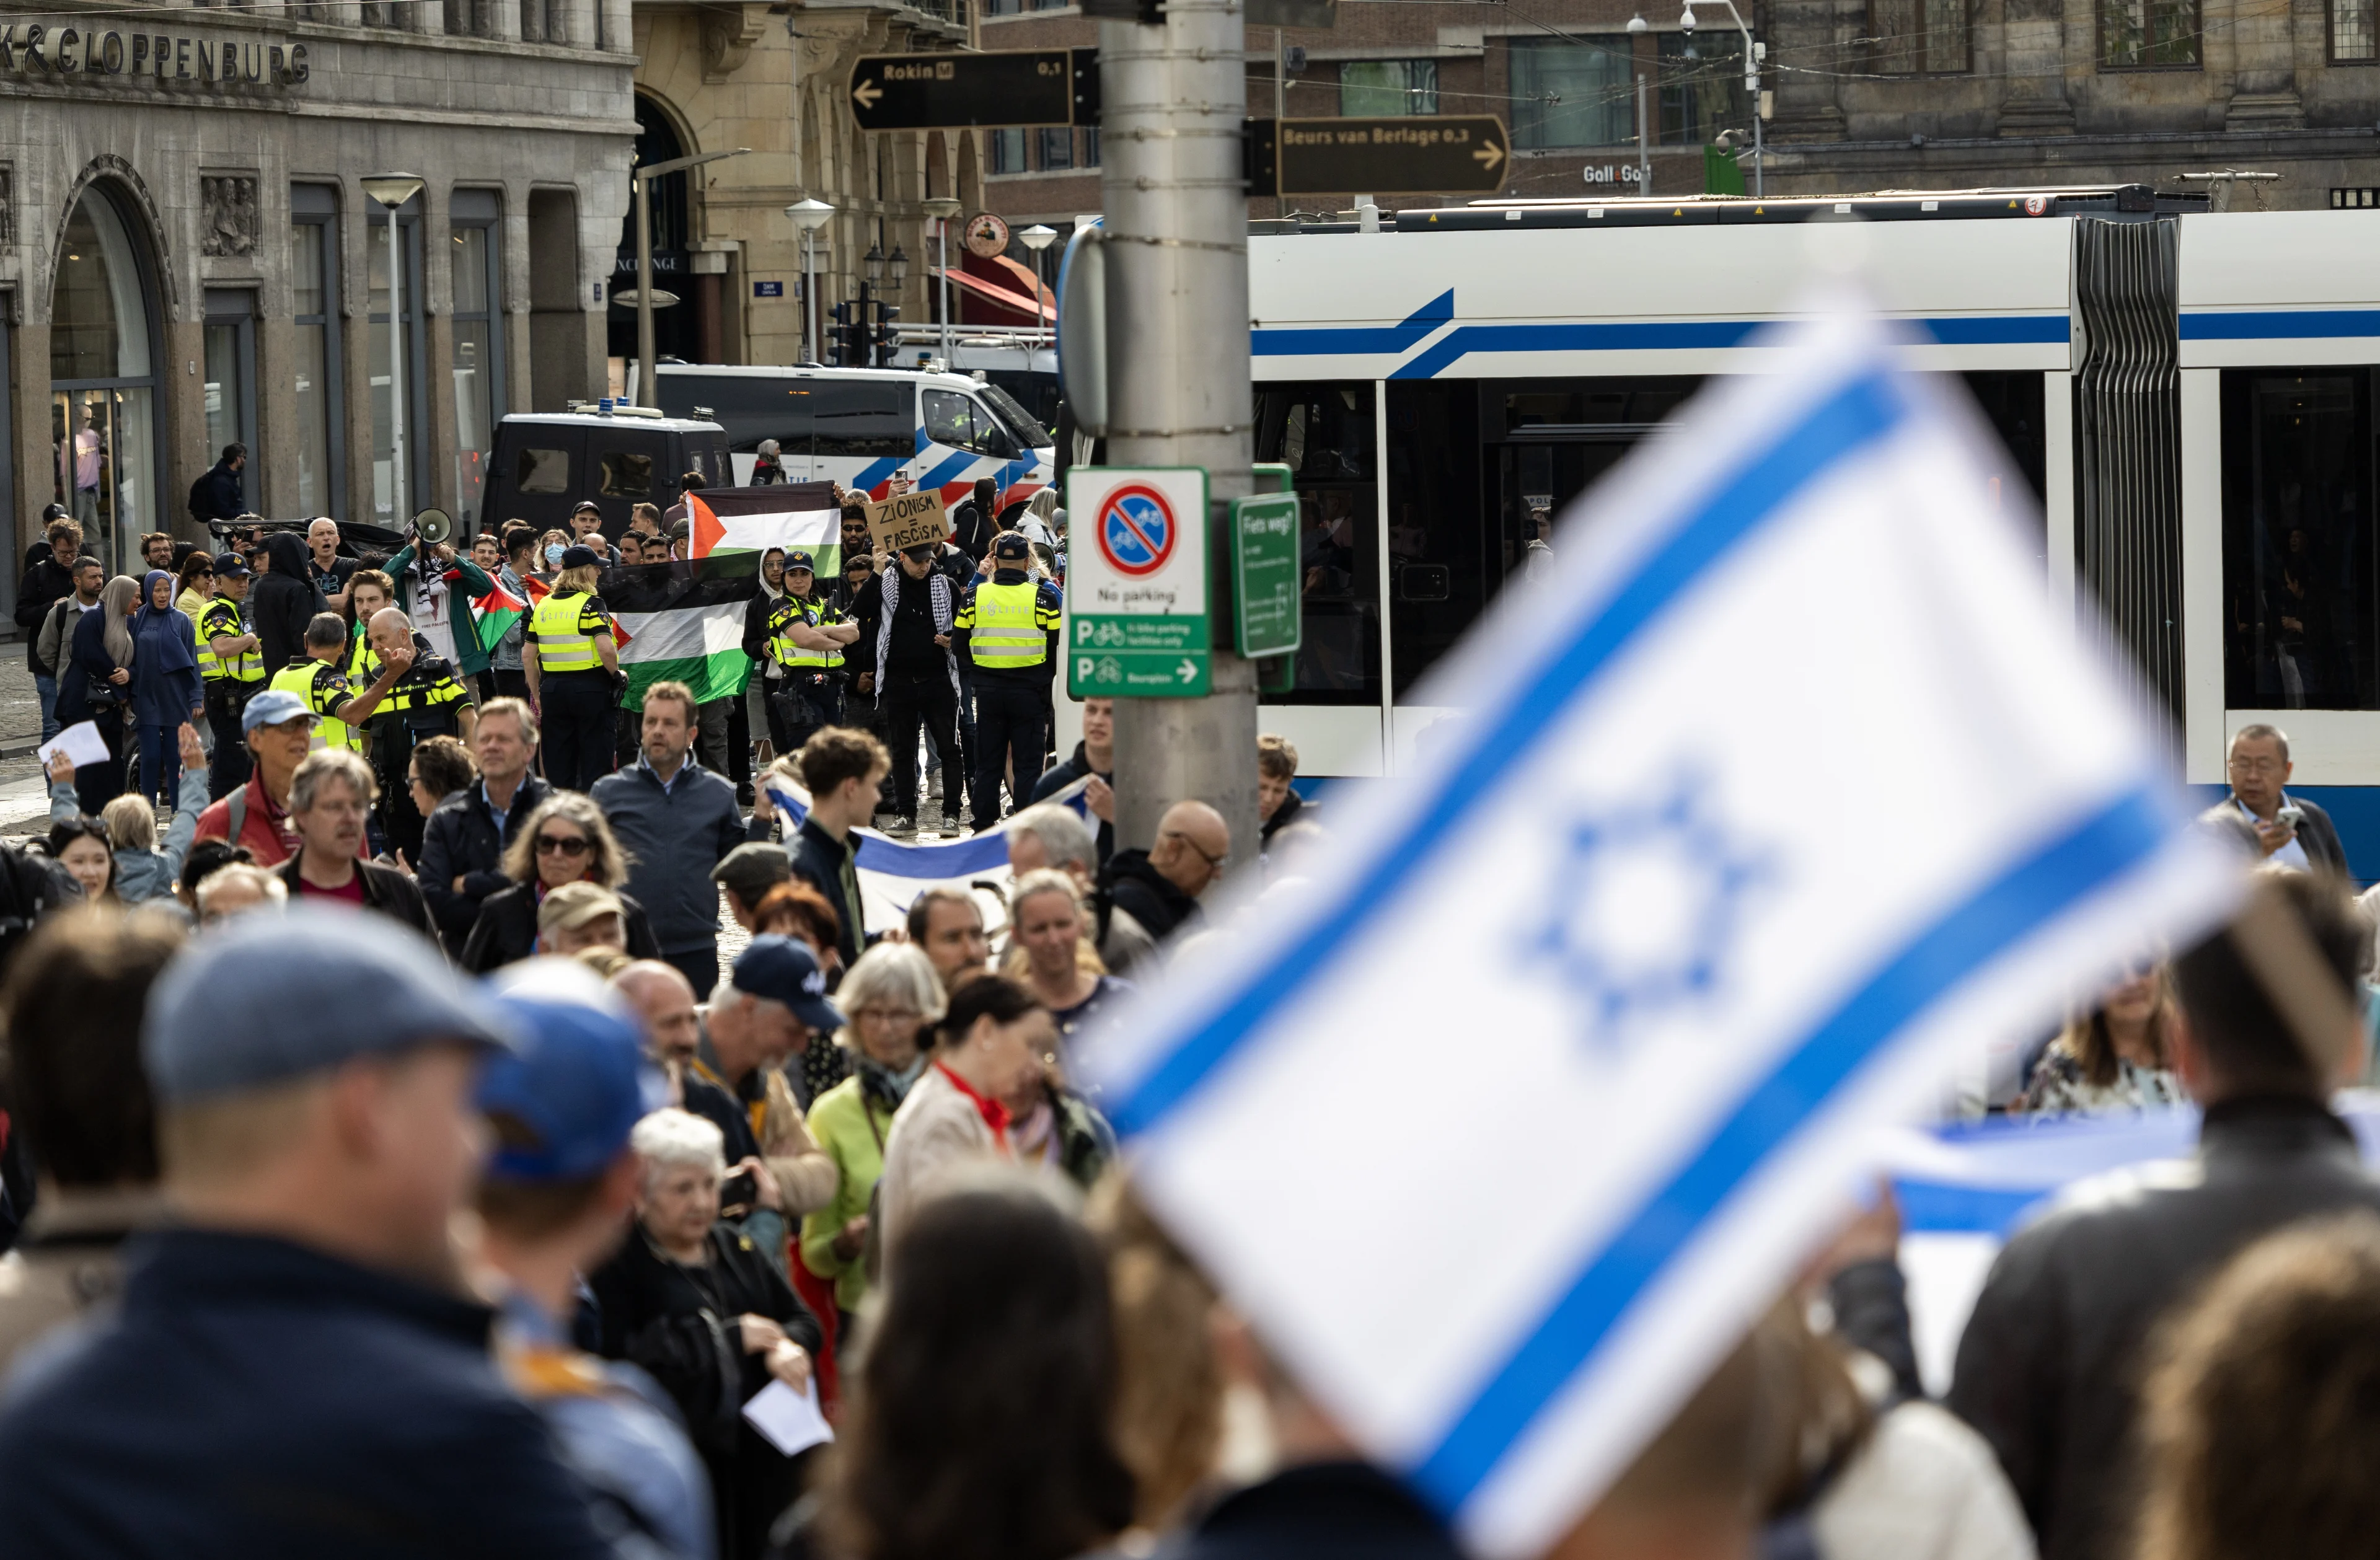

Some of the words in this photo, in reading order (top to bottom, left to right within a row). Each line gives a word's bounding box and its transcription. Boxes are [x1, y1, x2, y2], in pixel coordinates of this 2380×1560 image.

[24, 23, 50, 74] &
[58, 27, 309, 84] CLOPPENBURG
[884, 63, 933, 81] Rokin
[1284, 128, 1333, 145] Beurs
[1337, 131, 1368, 144] van
[1373, 127, 1440, 147] Berlage
[617, 257, 677, 271] XCNGE
[1243, 515, 1266, 535] Fiets
[1267, 509, 1294, 535] weg?
[1097, 589, 1119, 602] No
[1122, 588, 1176, 604] parking
[980, 602, 1029, 615] POLITIE
[1077, 620, 1094, 646] P
[1137, 623, 1156, 633] bike
[1157, 623, 1191, 636] parking
[1163, 637, 1183, 648] only
[1077, 658, 1095, 683] P
